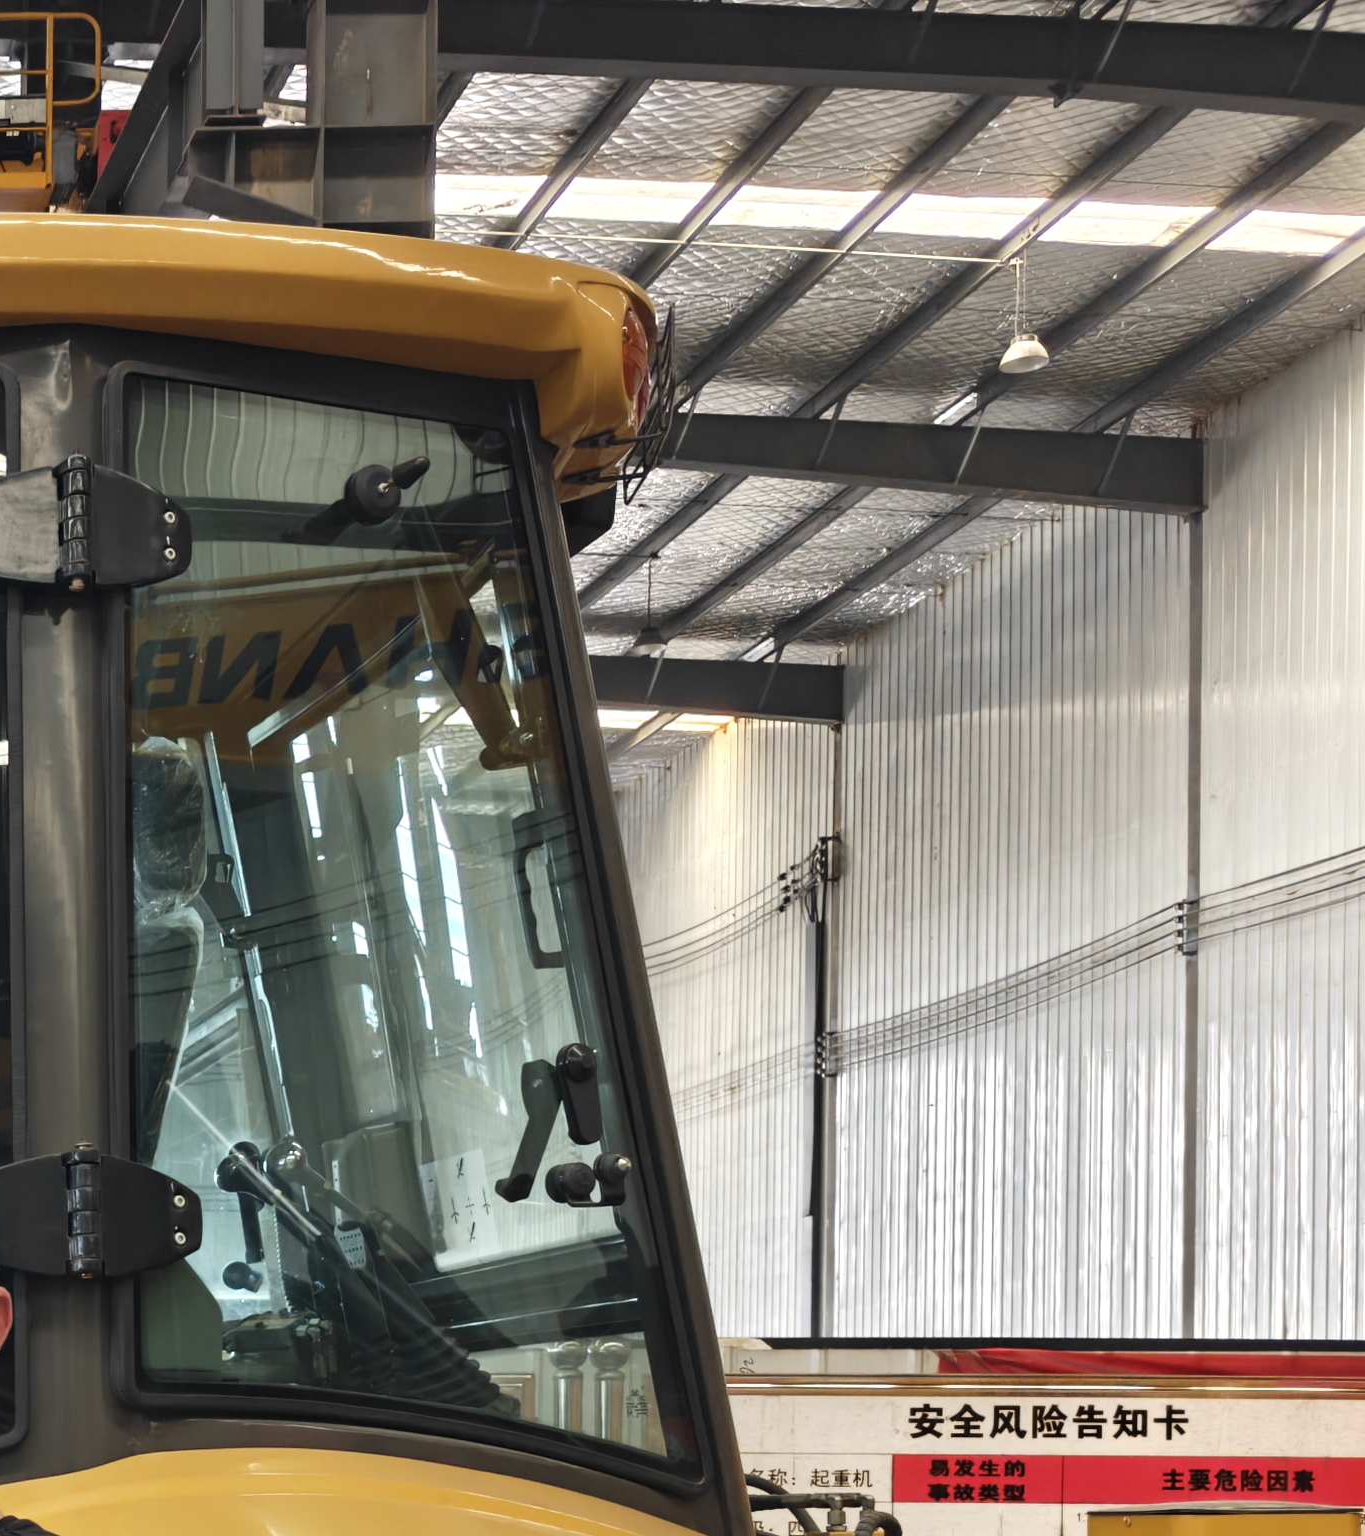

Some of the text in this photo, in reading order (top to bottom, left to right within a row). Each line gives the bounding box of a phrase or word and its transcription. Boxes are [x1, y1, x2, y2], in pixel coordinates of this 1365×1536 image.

[908, 1403, 1190, 1440] 安全风险告知卡
[928, 1459, 1026, 1478] 易发生的
[1161, 1468, 1316, 1493] 主要危险因素
[927, 1483, 1026, 1503] 事故类型
